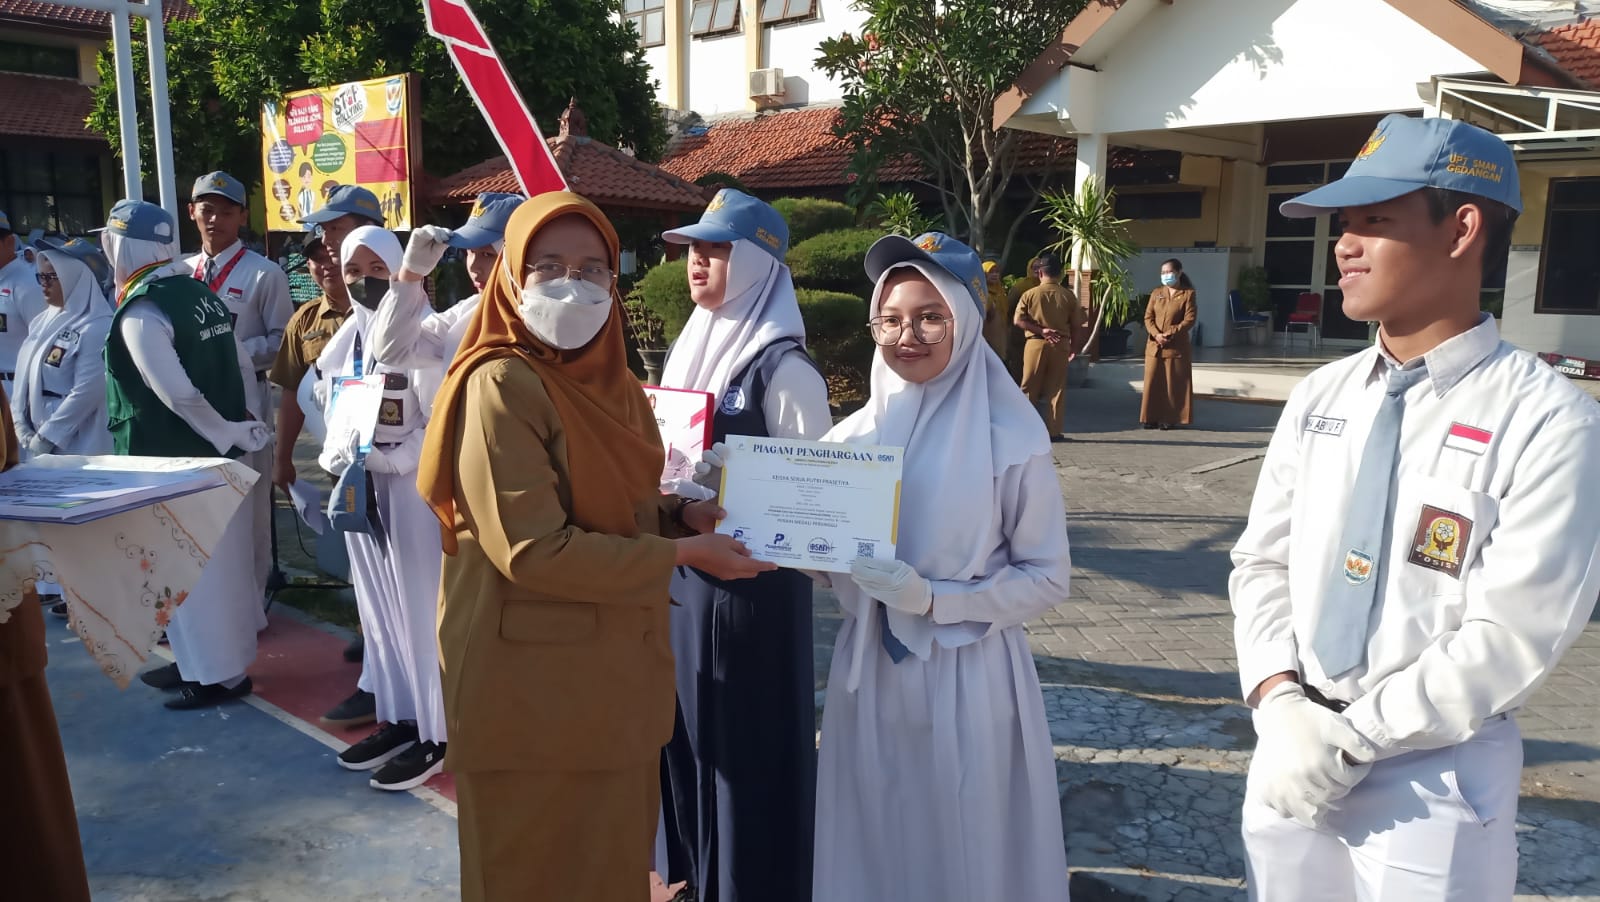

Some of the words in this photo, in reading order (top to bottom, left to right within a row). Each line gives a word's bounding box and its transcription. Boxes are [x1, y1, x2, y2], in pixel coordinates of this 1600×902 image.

[1449, 153, 1467, 164] UPT
[1472, 159, 1497, 172] SMAN
[1446, 163, 1502, 183] GEDANGAN
[194, 296, 225, 324] UKS
[753, 443, 793, 456] PIAGAM
[796, 447, 874, 462] PENGHARGAAN
[1423, 556, 1452, 569] OSIS
